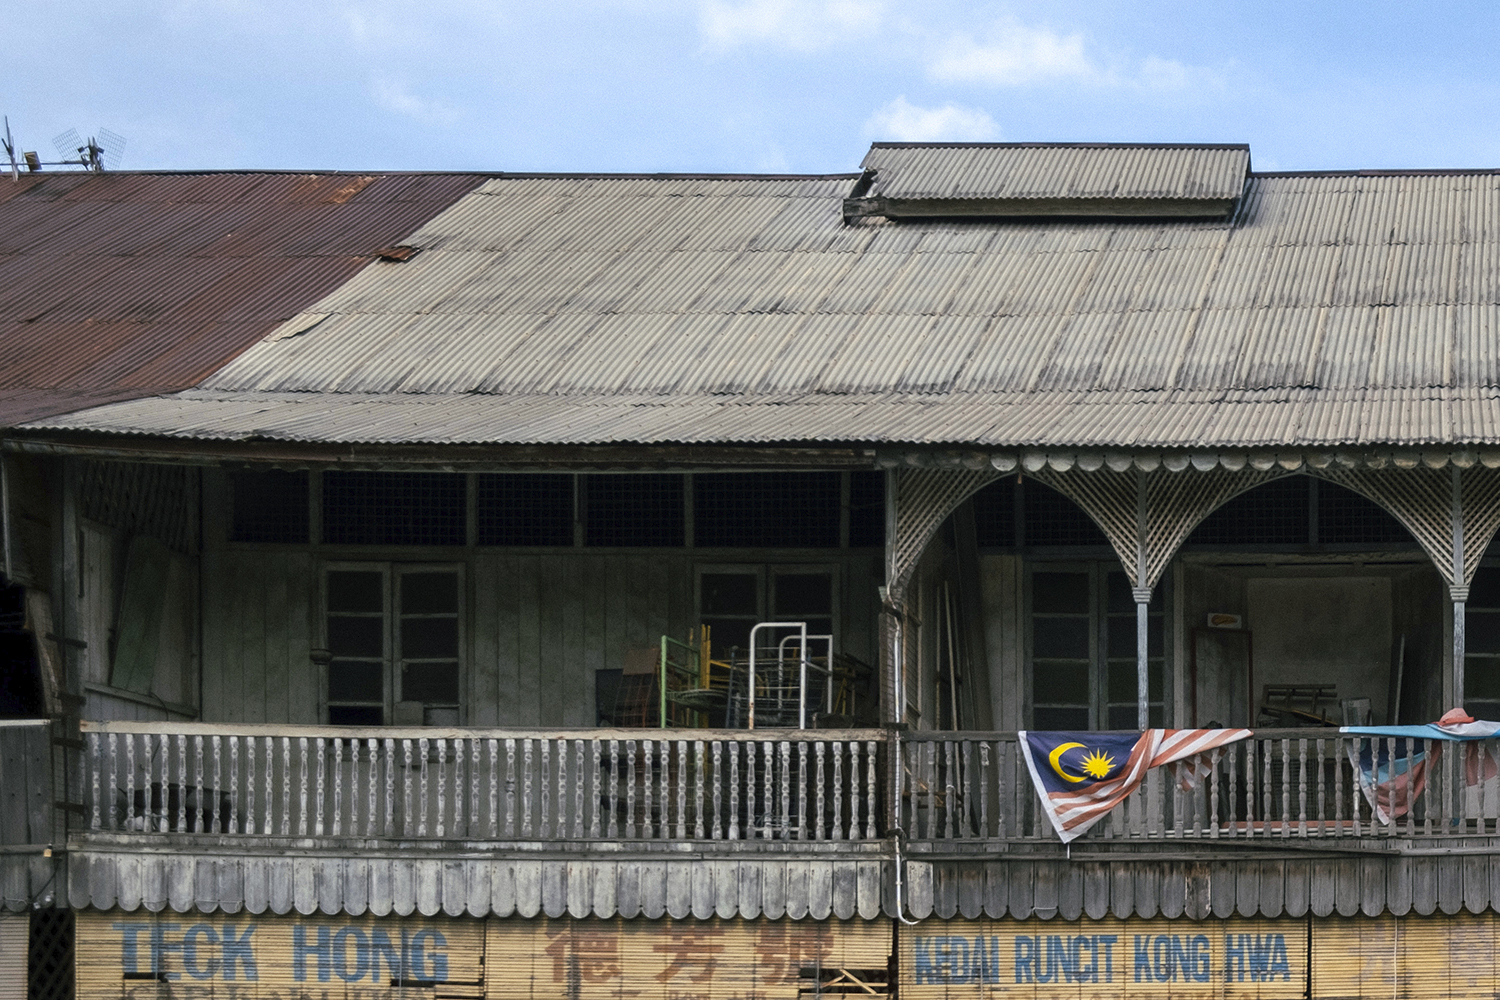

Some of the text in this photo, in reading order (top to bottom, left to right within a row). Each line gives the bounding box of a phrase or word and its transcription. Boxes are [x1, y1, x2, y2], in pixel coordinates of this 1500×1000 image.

[113, 921, 449, 982] TECK HONG
[915, 933, 1291, 985] KEDAI RUNCIT KONG HWA
